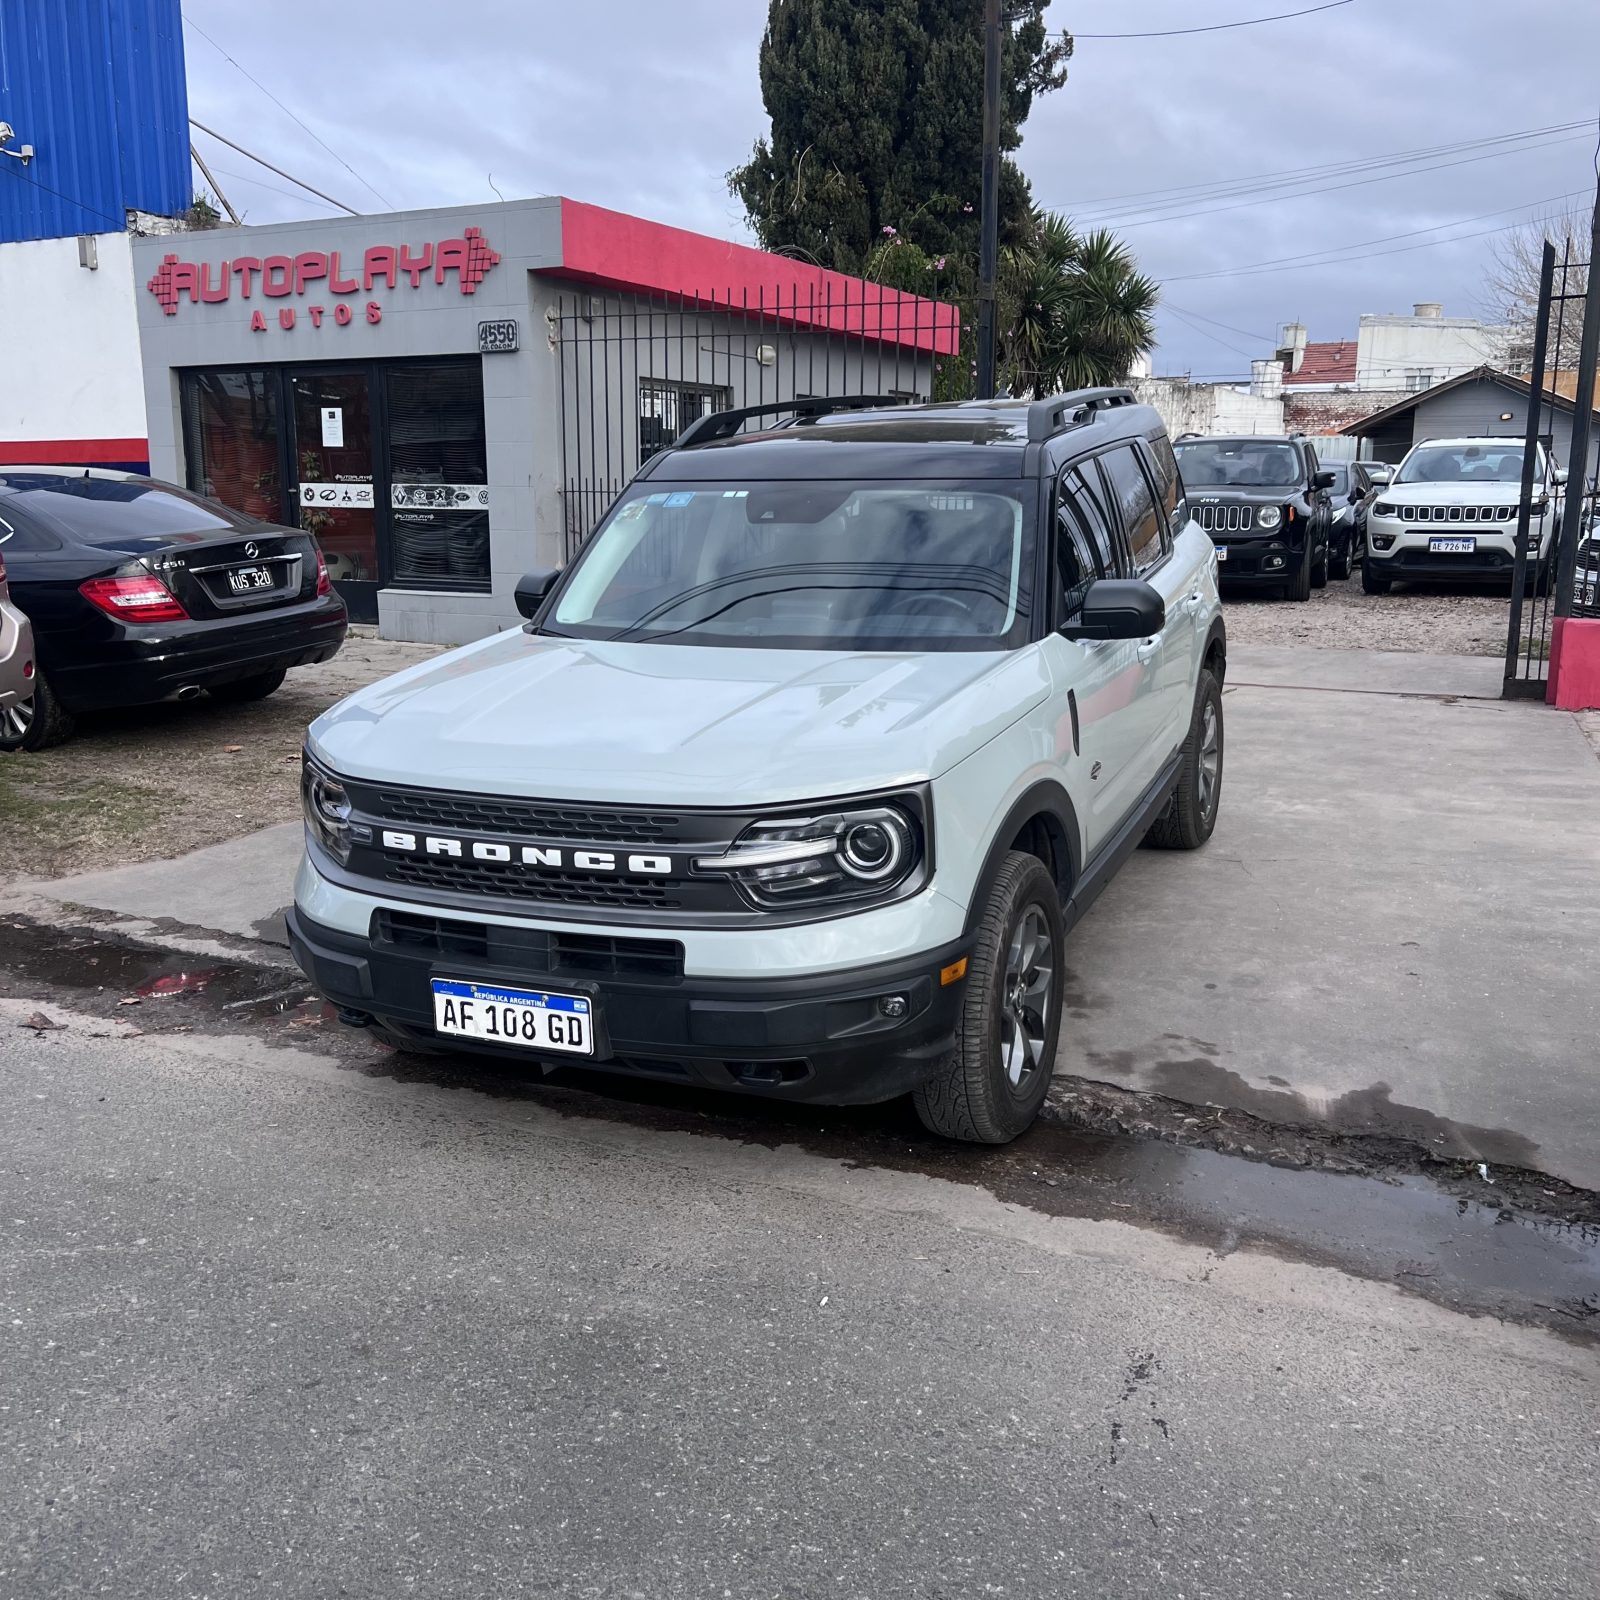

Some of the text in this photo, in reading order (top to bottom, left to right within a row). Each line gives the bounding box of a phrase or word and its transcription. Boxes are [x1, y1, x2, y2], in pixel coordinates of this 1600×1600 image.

[170, 238, 470, 303] AUTOPLAYA
[251, 302, 382, 331] AUTOS
[480, 323, 515, 345] 4550
[1432, 543, 1472, 552] AE 726 NF
[162, 559, 185, 569] 250
[229, 570, 271, 590] KUS 320
[383, 831, 672, 873] BRONCO
[474, 991, 546, 1008] REPÚBLICA ARGENTINA
[443, 998, 583, 1046] AF 108 GD
